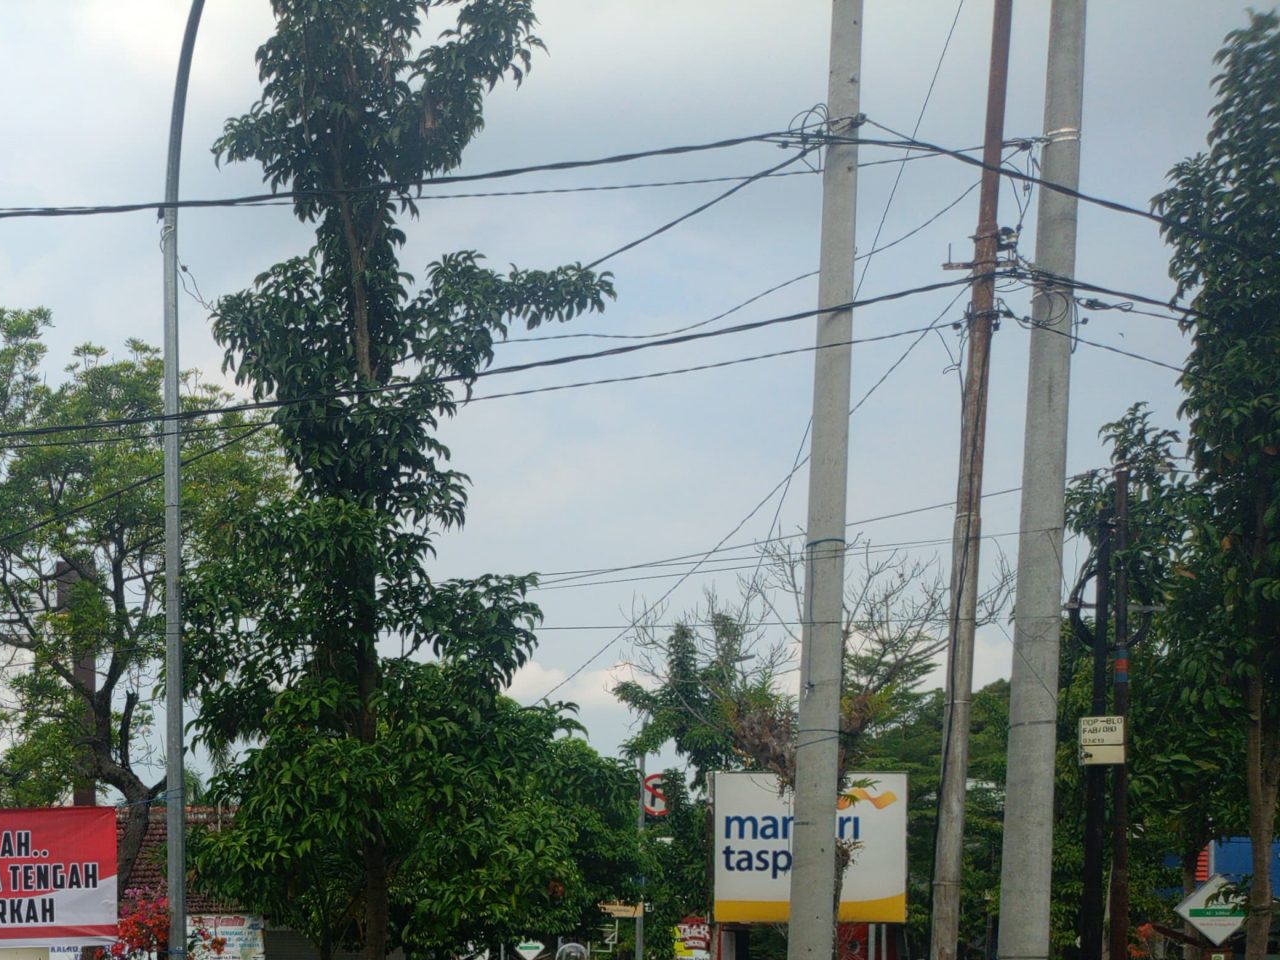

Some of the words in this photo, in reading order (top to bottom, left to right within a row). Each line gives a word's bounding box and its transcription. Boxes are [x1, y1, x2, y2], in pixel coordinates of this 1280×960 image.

[724, 815, 859, 840] mari
[8, 862, 99, 892] TENGAH
[723, 845, 793, 879] tasp
